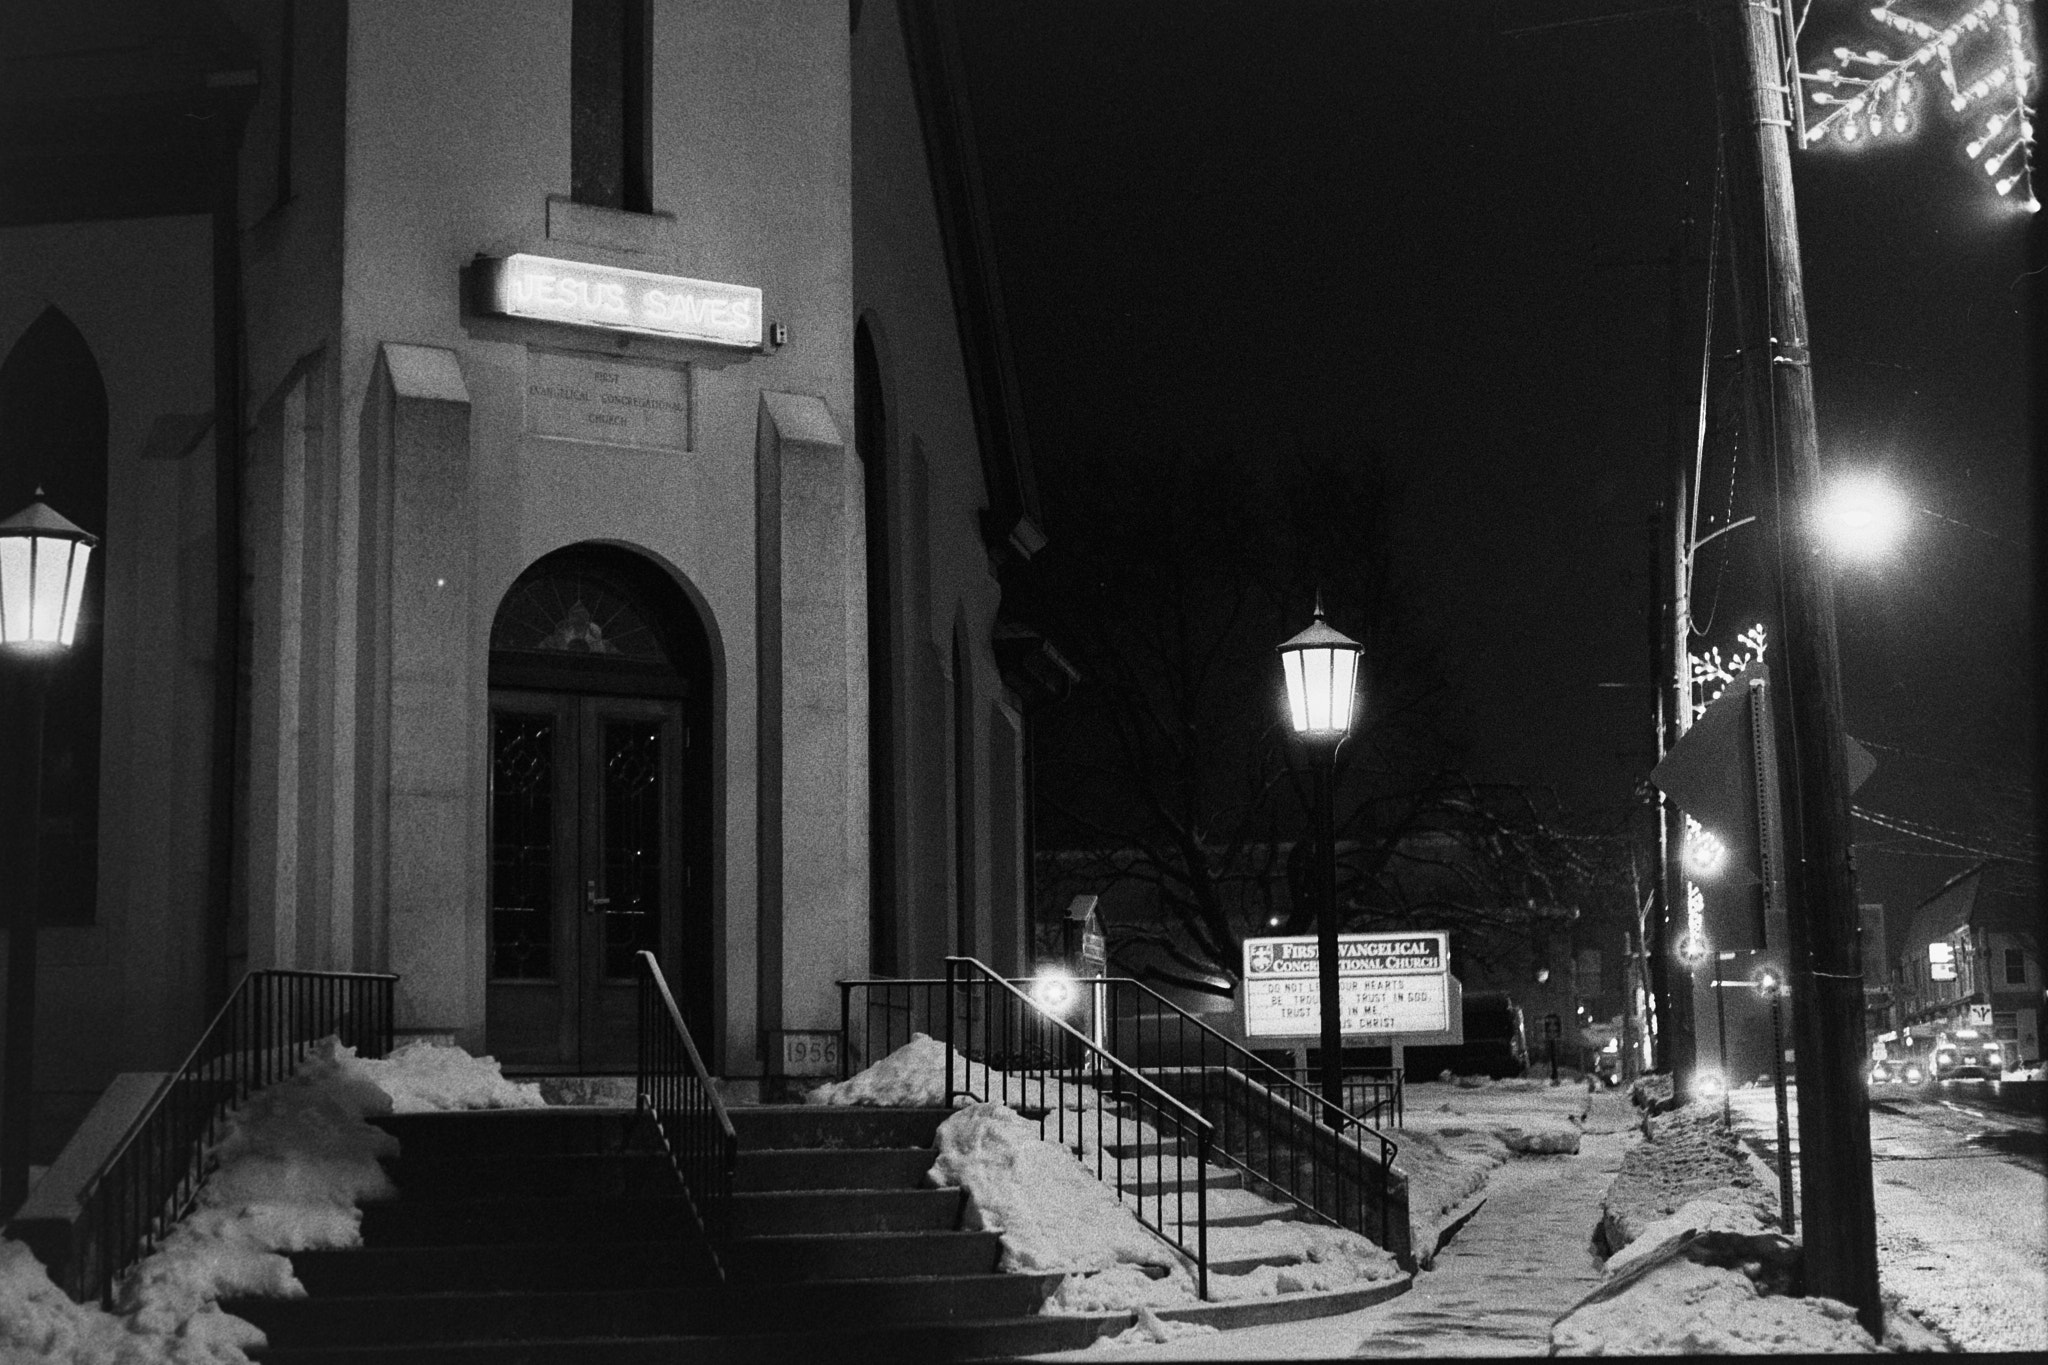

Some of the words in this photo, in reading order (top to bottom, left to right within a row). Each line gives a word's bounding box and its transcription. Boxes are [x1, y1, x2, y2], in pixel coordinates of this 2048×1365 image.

[514, 273, 629, 314] JESUS
[643, 289, 751, 330] SAVES
[594, 371, 620, 384] FIRST
[587, 413, 628, 427] CHURCH
[1337, 942, 1430, 957] VANGELICAL
[1385, 956, 1440, 970] CHURCH
[1285, 982, 1303, 993] NOT
[1339, 981, 1358, 991] OUR
[1364, 980, 1404, 991] HEARTS
[1271, 996, 1282, 1006] BE
[1356, 993, 1386, 1003] TRUST
[1393, 993, 1404, 1002] IN
[1281, 1007, 1311, 1018] TRUST
[1359, 1018, 1395, 1028] CHRIST
[787, 1042, 836, 1063] 1956
